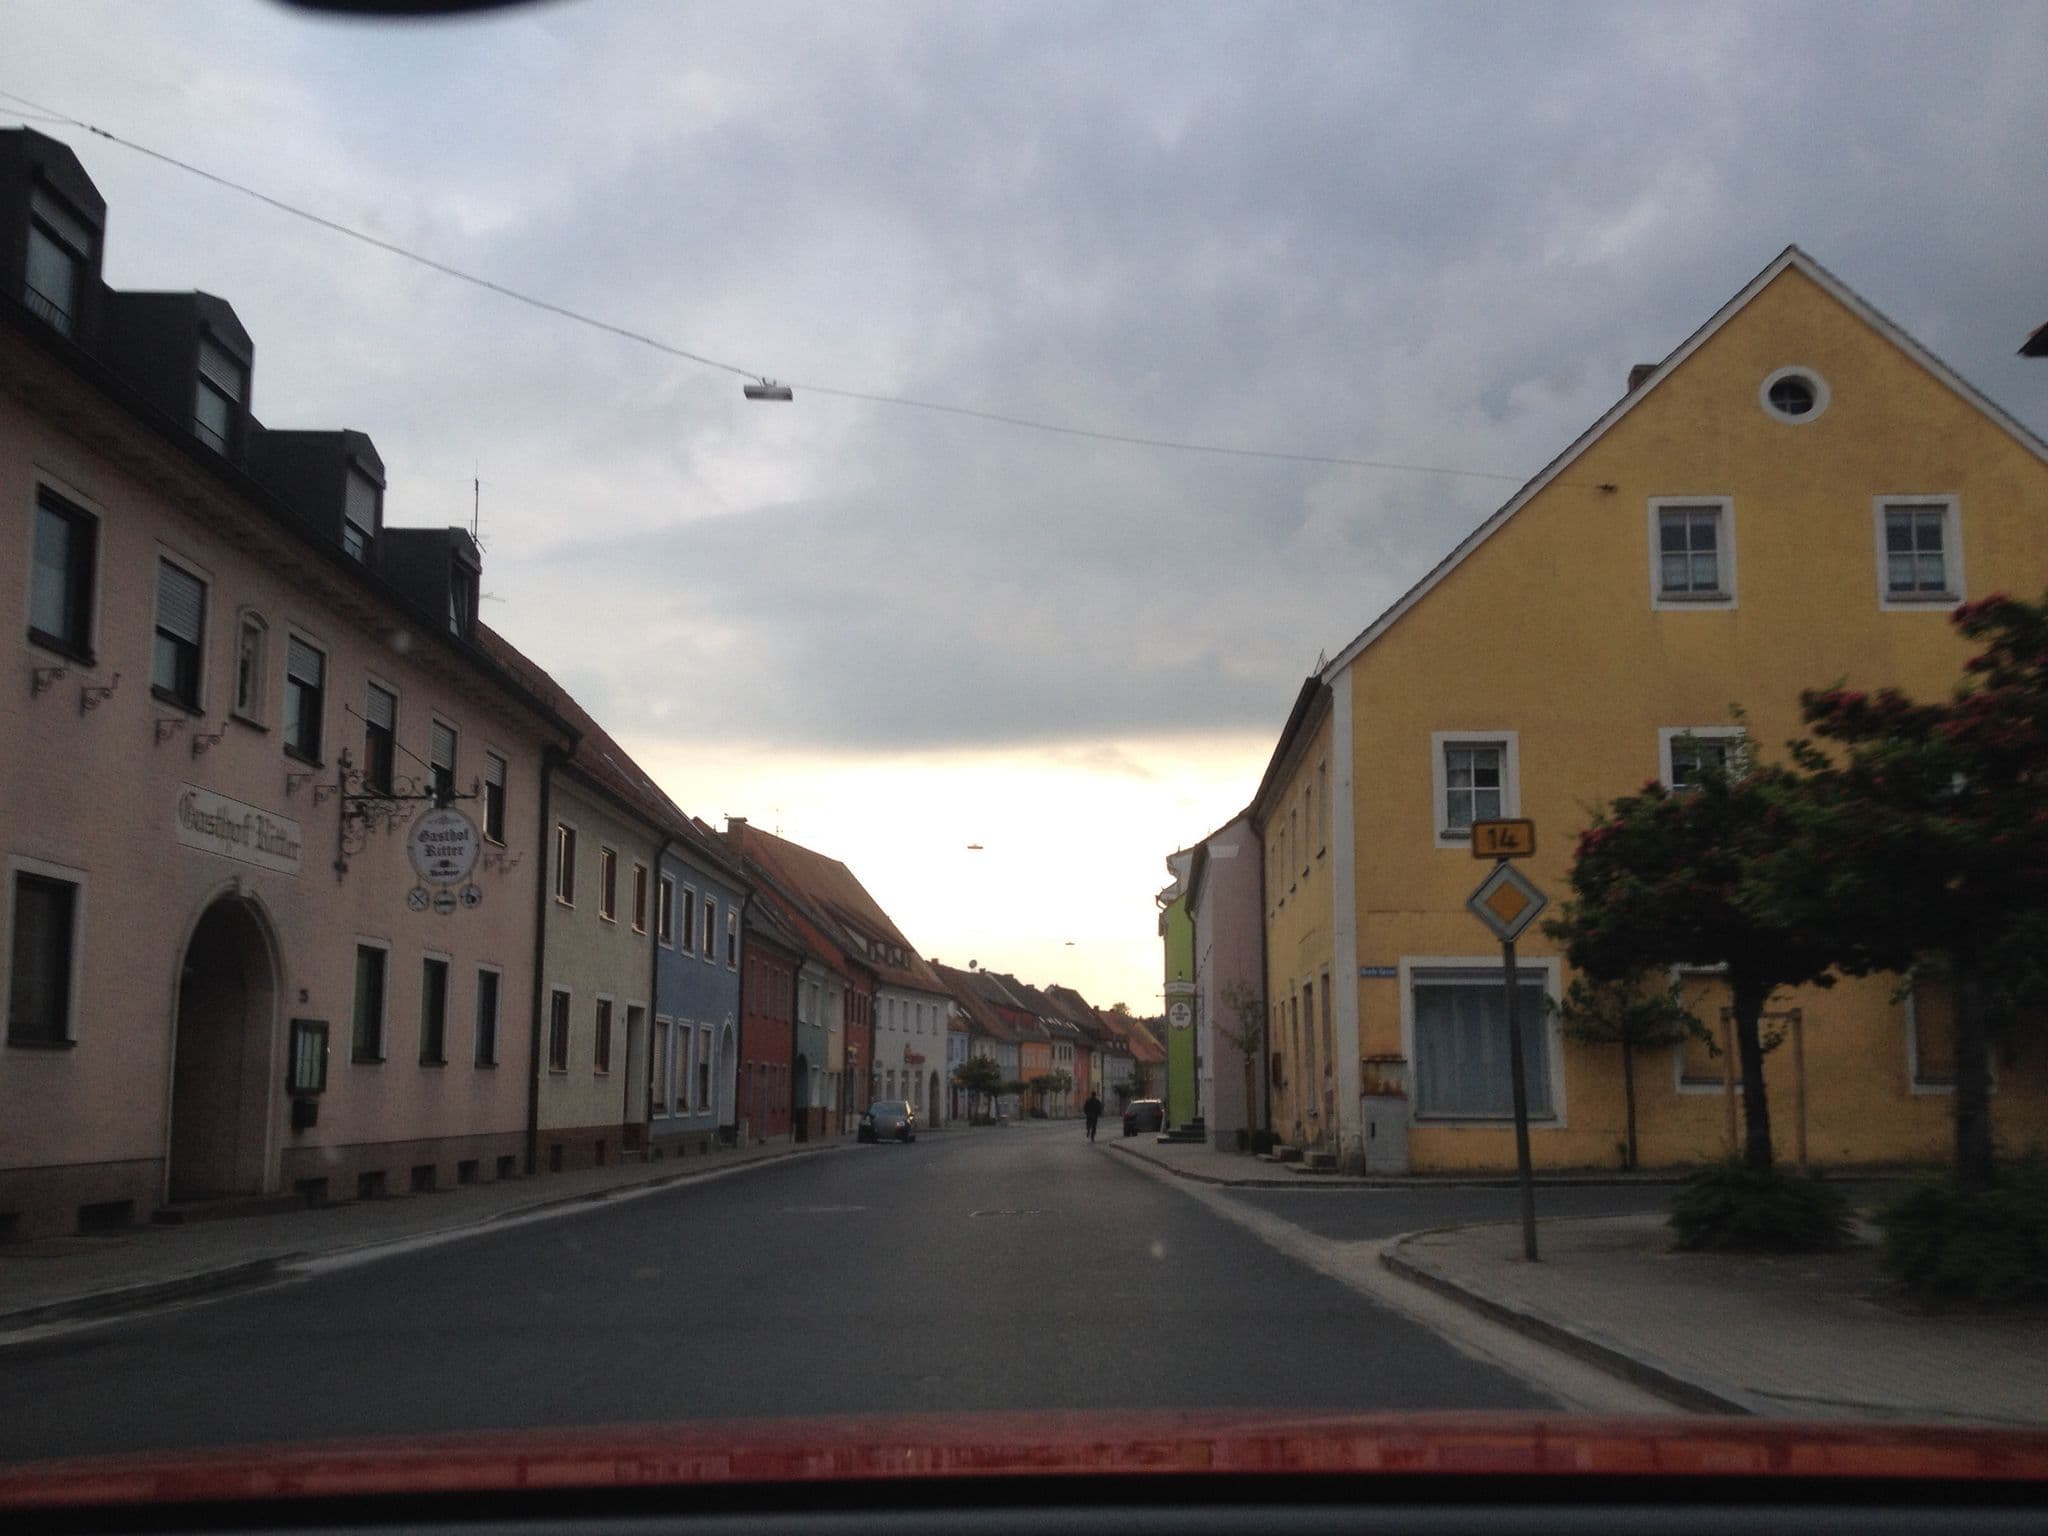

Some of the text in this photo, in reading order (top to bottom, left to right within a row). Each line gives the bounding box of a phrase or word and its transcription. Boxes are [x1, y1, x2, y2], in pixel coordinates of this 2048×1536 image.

[179, 791, 254, 856] Gasthof
[418, 828, 469, 842] Gasthof
[1488, 827, 1519, 849] 14
[425, 844, 464, 857] Ritter
